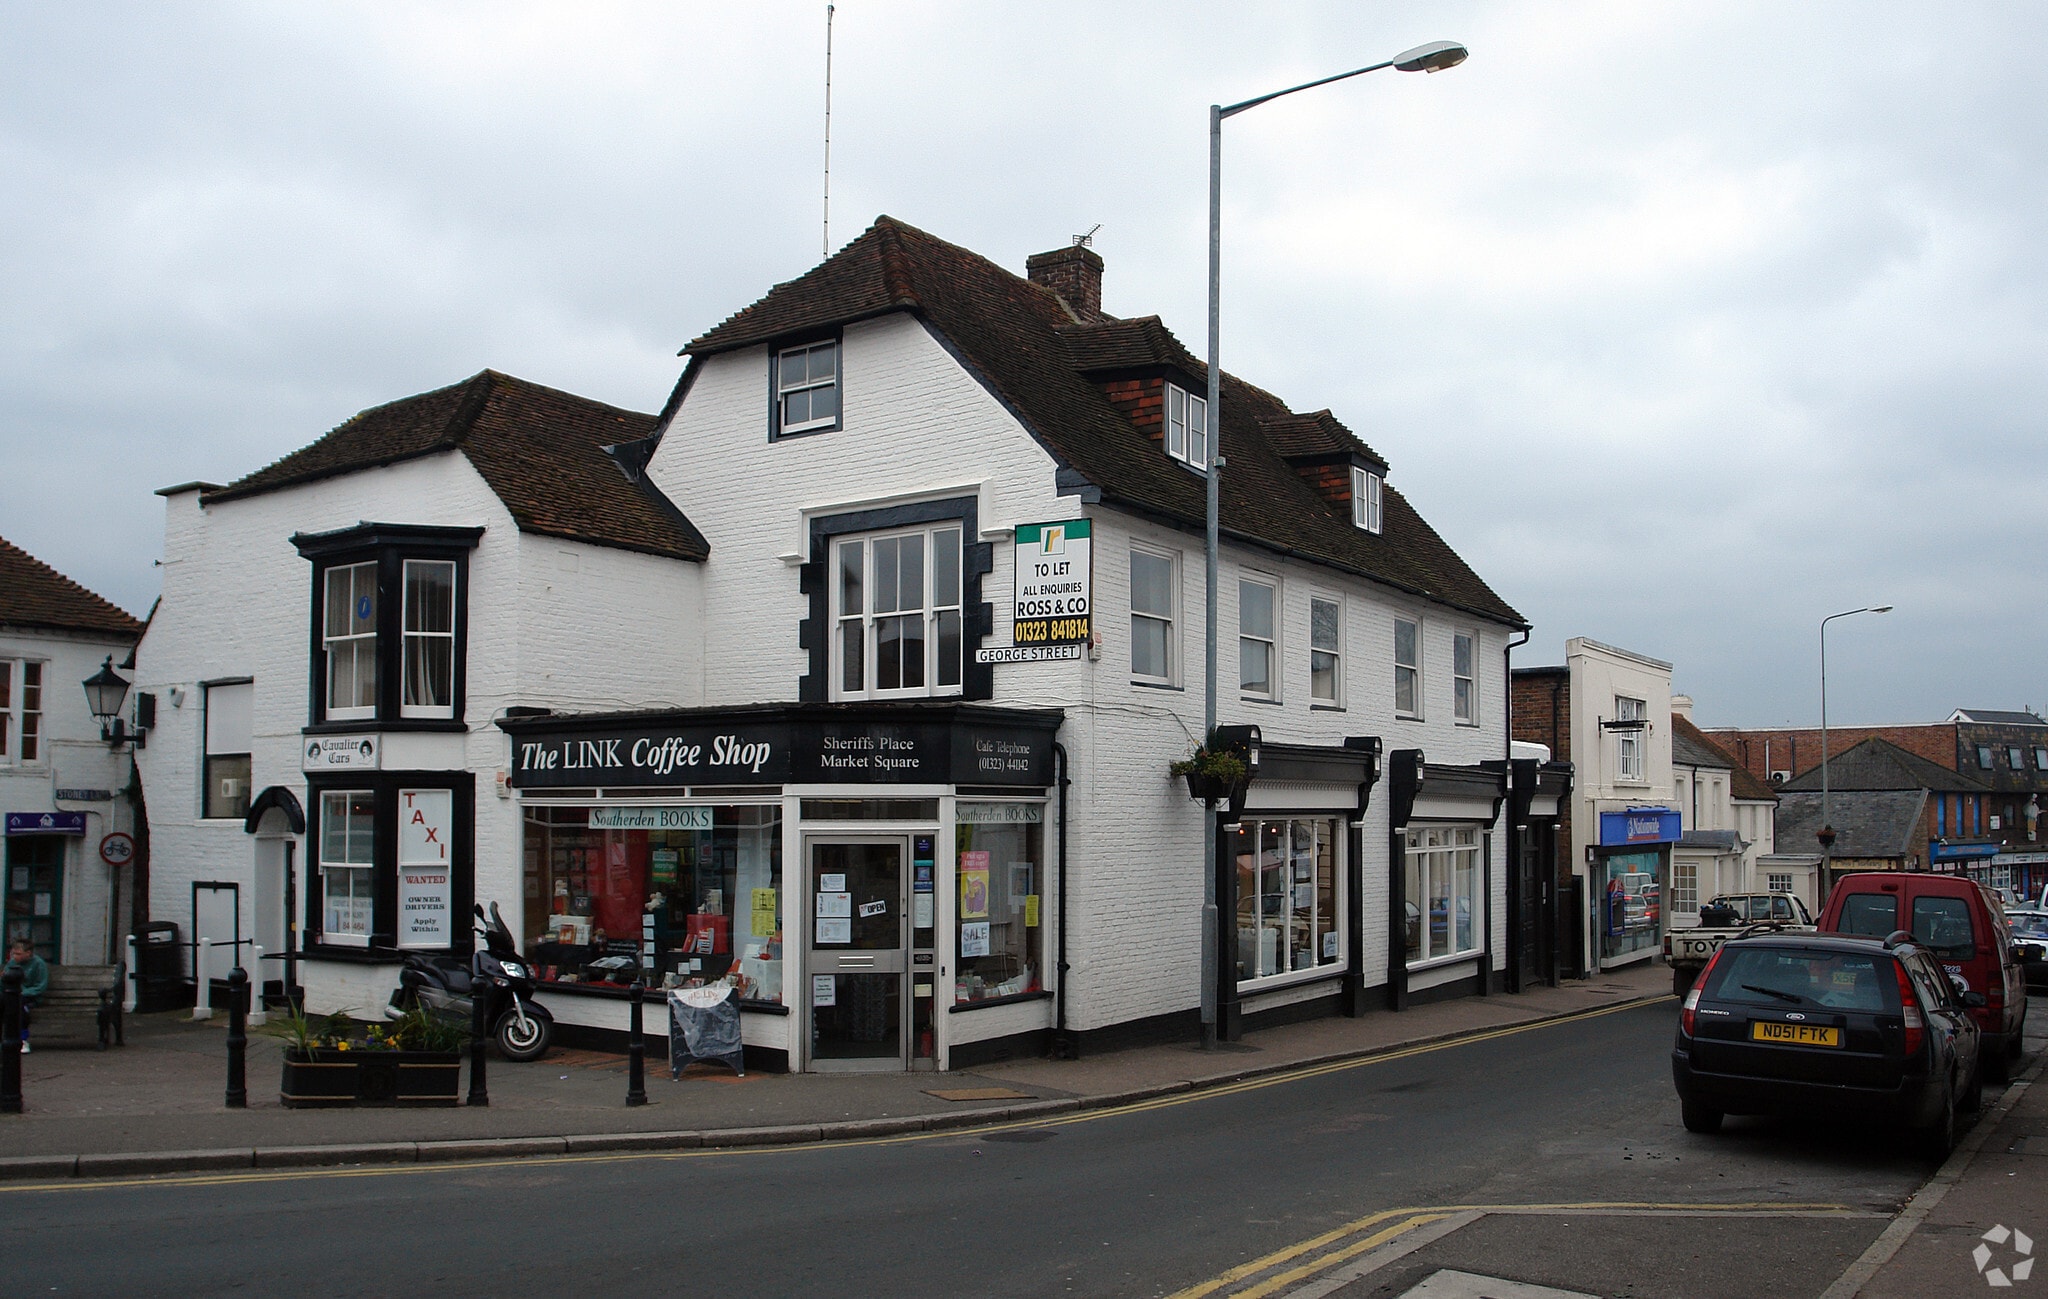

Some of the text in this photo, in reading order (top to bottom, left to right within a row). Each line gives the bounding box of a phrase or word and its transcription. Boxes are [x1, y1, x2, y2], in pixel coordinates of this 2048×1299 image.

[1035, 562, 1070, 577] TO LET
[1023, 582, 1082, 597] ALL ENQUIRIES
[1018, 597, 1087, 616] ROSS & CO
[1016, 618, 1089, 642] 01323 841814
[980, 646, 1076, 662] GEORGE STREET
[321, 739, 359, 751] Cavalier
[824, 737, 914, 750] Sheriffs Place
[976, 740, 1030, 756] Cafe Telephone
[328, 752, 350, 764] Cars
[521, 735, 771, 775] The LINK Coffee Shop
[821, 755, 920, 771] Market Square
[979, 757, 1005, 773] (01323)
[592, 809, 709, 827] Southerden BOOKS
[956, 807, 1037, 821] Southerden BOOKS
[404, 793, 445, 858] TAXI
[405, 875, 446, 884] WANTED
[867, 903, 885, 914] OPEN
[1683, 941, 1726, 953] TOY
[1763, 1024, 1828, 1042] ND51 FTK
